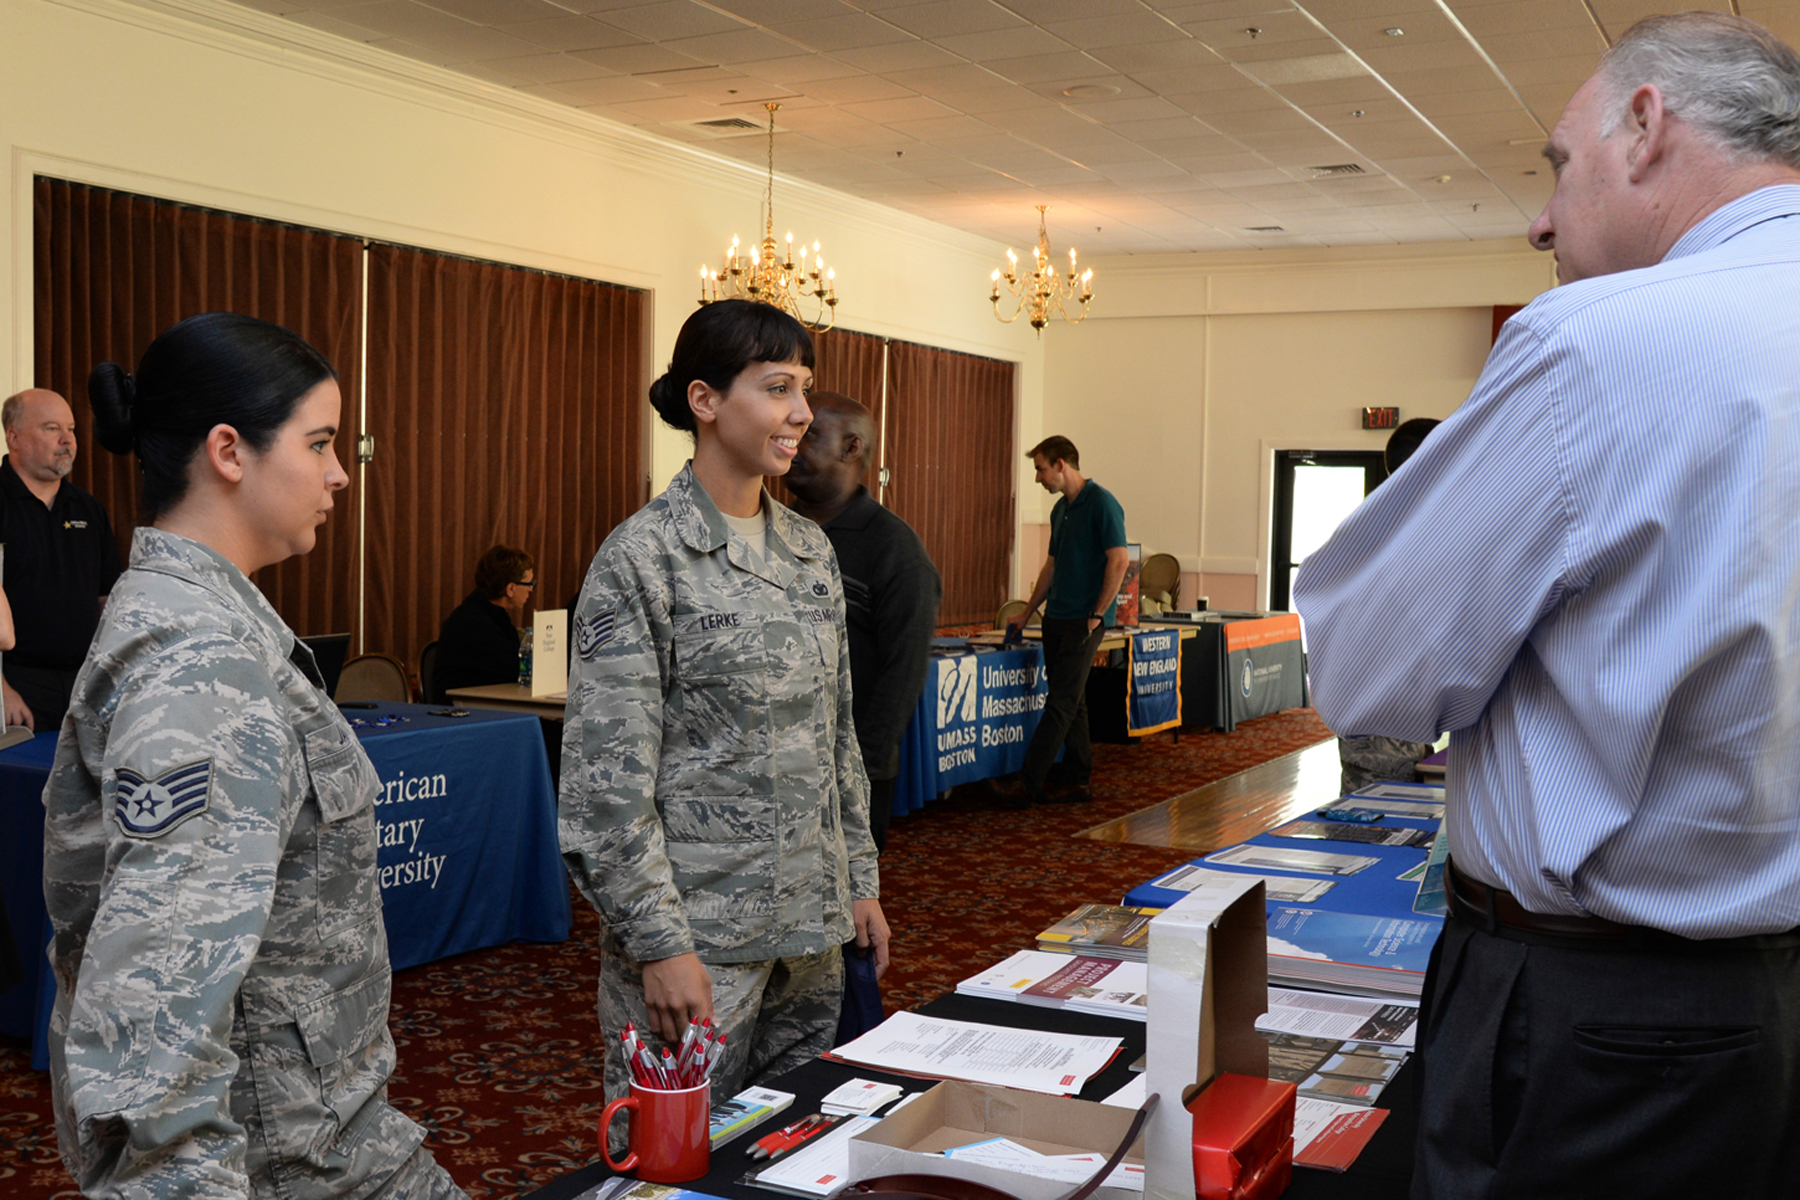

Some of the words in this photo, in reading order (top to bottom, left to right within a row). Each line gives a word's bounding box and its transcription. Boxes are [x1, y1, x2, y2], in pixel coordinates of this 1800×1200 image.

[1368, 408, 1394, 428] EXIT
[700, 612, 741, 631] LERKE
[1142, 635, 1171, 653] WESTERN
[983, 665, 1039, 689] University
[1149, 657, 1178, 676] ENGLAND
[982, 692, 1049, 718] Massachus
[937, 726, 977, 752] UMASS
[982, 723, 1023, 747] Boston
[938, 747, 976, 773] BOSTON
[373, 770, 447, 806] erican
[375, 818, 425, 853] tary
[377, 850, 446, 889] ersity
[1042, 961, 1098, 994] MANAGEMENT
[1077, 962, 1113, 985] PROJECT
